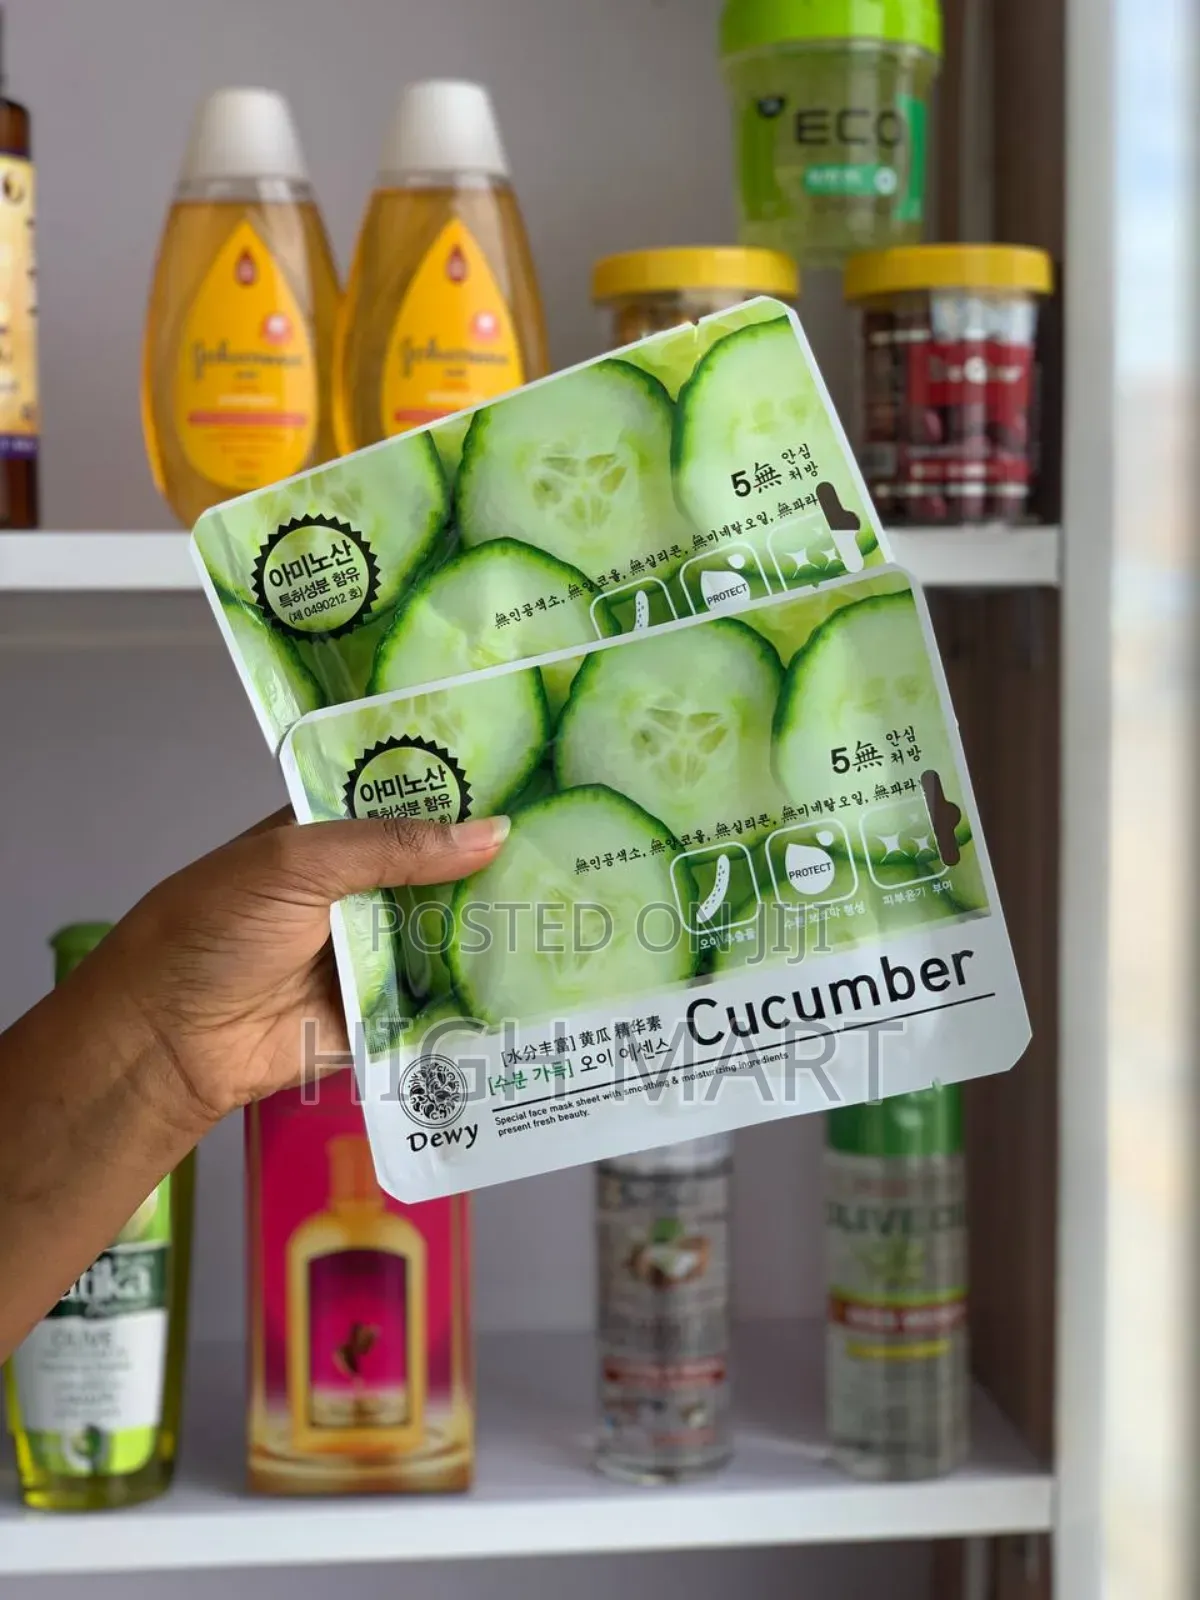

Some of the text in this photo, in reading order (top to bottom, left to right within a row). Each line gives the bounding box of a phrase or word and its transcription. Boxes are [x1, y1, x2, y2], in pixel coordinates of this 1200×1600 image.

[796, 108, 905, 149] ECO
[781, 443, 811, 465] 안심
[731, 462, 782, 498] 5無
[789, 460, 818, 482] 처방
[269, 540, 354, 587] 아미노산
[278, 566, 361, 609] 특허성분 함유
[707, 583, 748, 606] PROTECT
[304, 593, 347, 618] 0490212
[885, 725, 917, 747] 안심
[831, 740, 884, 774] 5無
[890, 745, 922, 765] 처방
[360, 764, 448, 804] 아미노산
[873, 778, 921, 801] 無파라
[423, 793, 452, 813] 함유
[788, 862, 832, 881] PROTECT
[686, 949, 974, 1046] Cucumber
[501, 1035, 576, 1068] [水分丰富]
[578, 1027, 612, 1050] 黄瓜
[488, 1037, 674, 1096] [수분 가득] 오이 에센스
[495, 1051, 789, 1126] Special face mask sheet with smoothing & moisturizing ingredients
[406, 1123, 478, 1152] Dewy
[498, 1109, 590, 1137] present fresh beauty.
